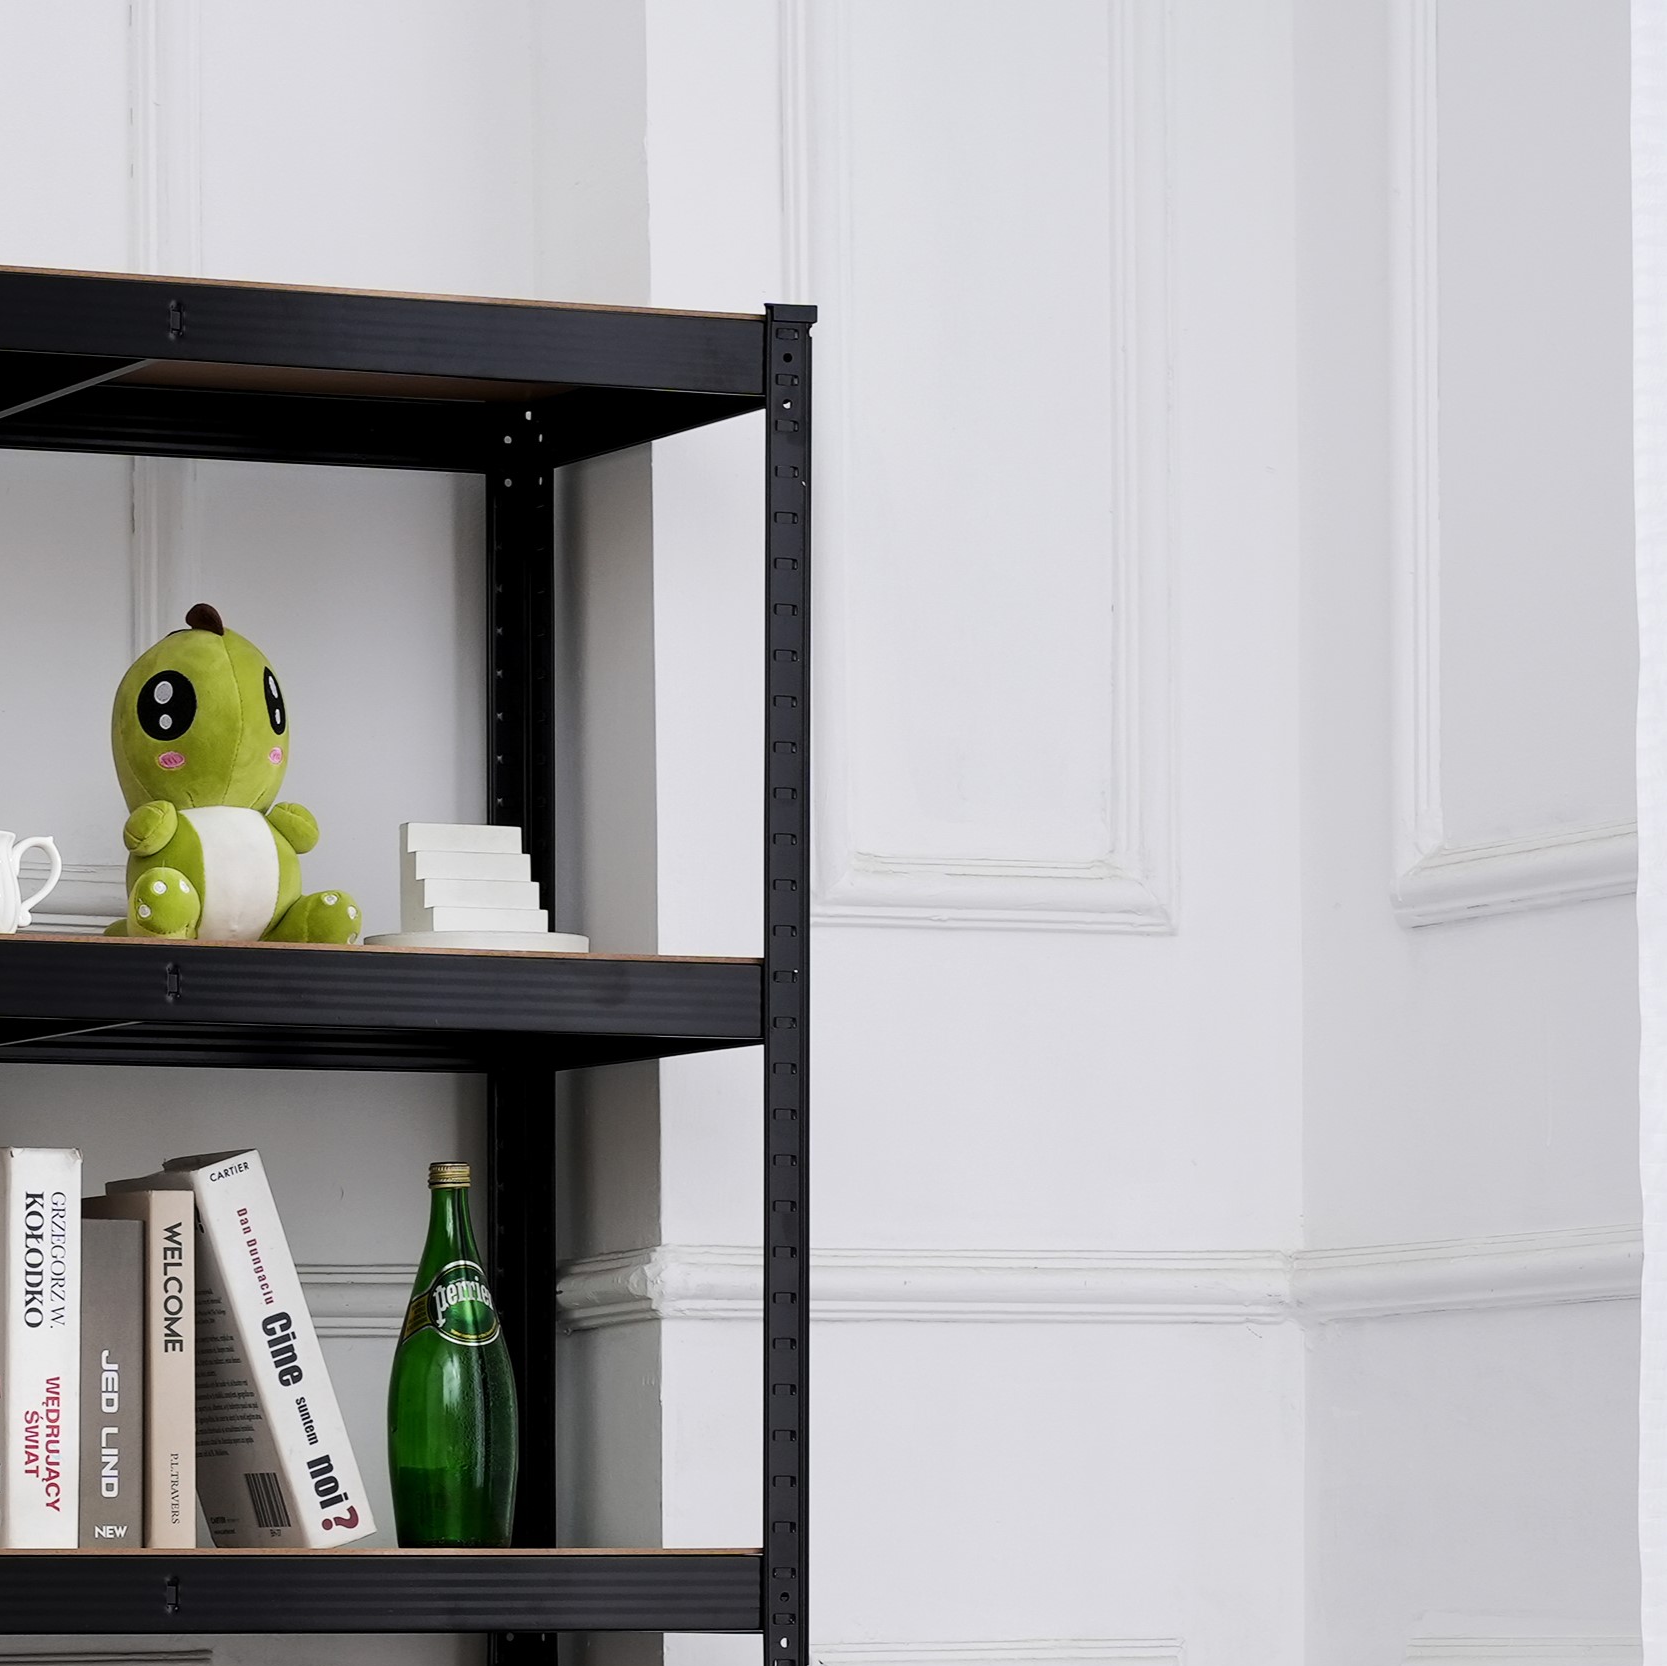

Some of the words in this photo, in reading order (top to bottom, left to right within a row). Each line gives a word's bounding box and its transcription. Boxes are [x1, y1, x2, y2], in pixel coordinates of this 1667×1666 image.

[210, 1162, 250, 1181] CARTIER
[50, 1192, 66, 1301] GRZEGORZ
[237, 1208, 252, 1234] Dan
[24, 1192, 46, 1328] KOŁODKO
[164, 1222, 184, 1354] WELCOME
[50, 1304, 66, 1329] W.
[262, 1311, 303, 1386] Cine
[101, 1350, 119, 1414] JED
[24, 1410, 42, 1477] ŚWIAT
[42, 1377, 61, 1512] WĘDRUJĄCY
[296, 1397, 318, 1445] suntem
[101, 1427, 119, 1498] LIND
[306, 1455, 359, 1530] noi?
[95, 1525, 127, 1538] NEW
